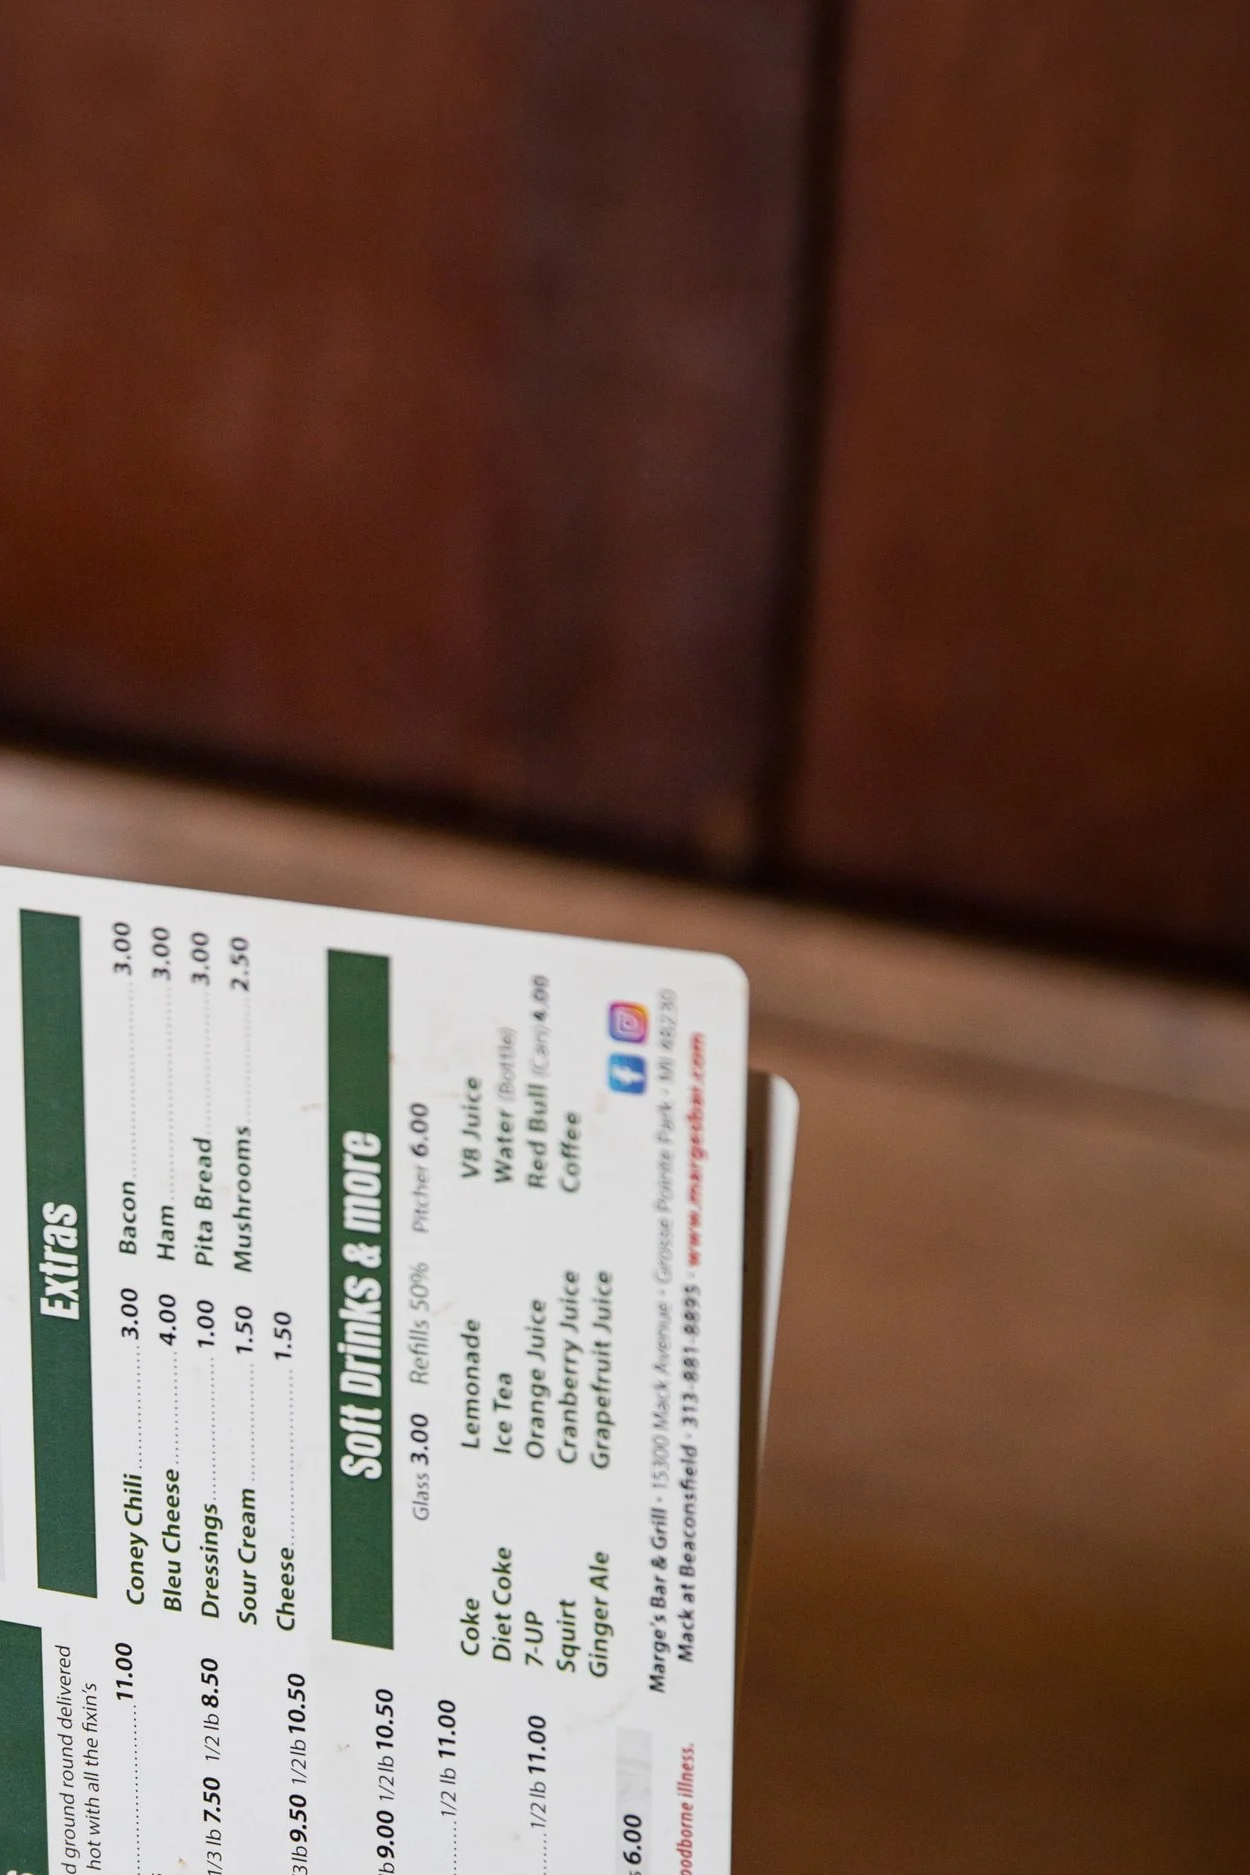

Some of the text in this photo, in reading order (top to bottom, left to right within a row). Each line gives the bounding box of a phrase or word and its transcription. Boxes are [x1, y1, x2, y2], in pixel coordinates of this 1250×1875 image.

[39, 1201, 80, 1320] Extras
[337, 1130, 382, 1479] Soft Drinks & more
[119, 1287, 149, 1606] Coney Chili 3.00
[195, 1298, 223, 1619] Dressings 1.00
[234, 1304, 258, 1626] Sour Cream 1.50
[272, 1310, 296, 1632] Cheese 1.50
[458, 1597, 481, 1658] Coke
[490, 1546, 513, 1663] Diet Coke
[523, 1609, 545, 1668] 7-UP
[555, 1598, 581, 1674] Squirt
[587, 1550, 615, 1680] Ginger Ale
[676, 1743, 695, 1799] illness.
[622, 1812, 643, 1866] 6.00
